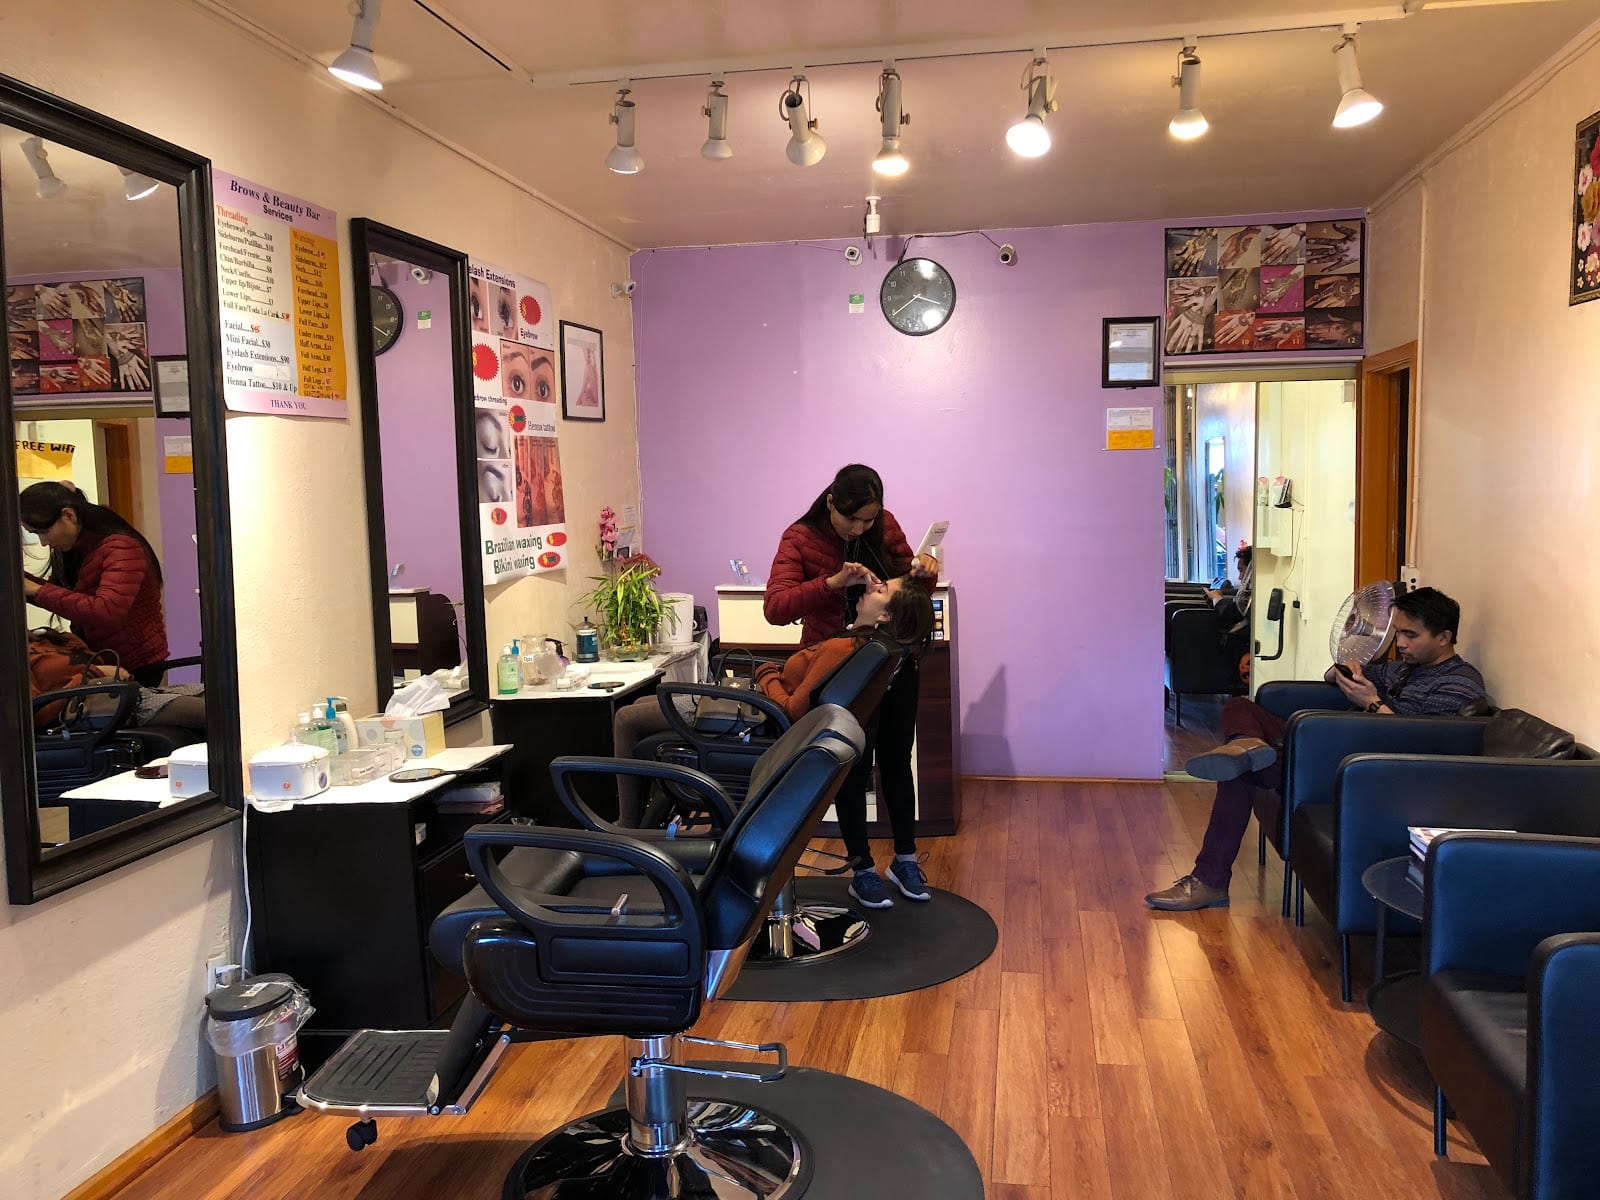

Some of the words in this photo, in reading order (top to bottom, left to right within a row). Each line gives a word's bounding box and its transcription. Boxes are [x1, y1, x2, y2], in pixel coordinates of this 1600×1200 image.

[231, 180, 260, 200] Brows
[262, 192, 270, 204] &
[273, 195, 303, 217] Beauty
[306, 207, 320, 220] Bar
[216, 204, 248, 225] Threading
[263, 204, 293, 223] Services
[486, 269, 516, 289] Extensions
[521, 303, 527, 316] $
[225, 320, 243, 331] Facial
[226, 333, 240, 344] Mini
[242, 336, 258, 346] Facial
[520, 328, 538, 340] Eyebrow
[227, 347, 249, 358] Eyelash
[250, 350, 277, 362] Extensions
[227, 361, 253, 372] Eyebrow
[227, 376, 247, 387] Henna
[289, 383, 298, 394] Up
[271, 400, 293, 409] THANK
[294, 401, 306, 410] YOU
[528, 420, 542, 431] Henna
[15, 441, 45, 452] FREE
[485, 538, 515, 555] Brazilian
[516, 534, 542, 550] waxing
[494, 557, 513, 575] Bikini
[514, 554, 535, 569] waxing
